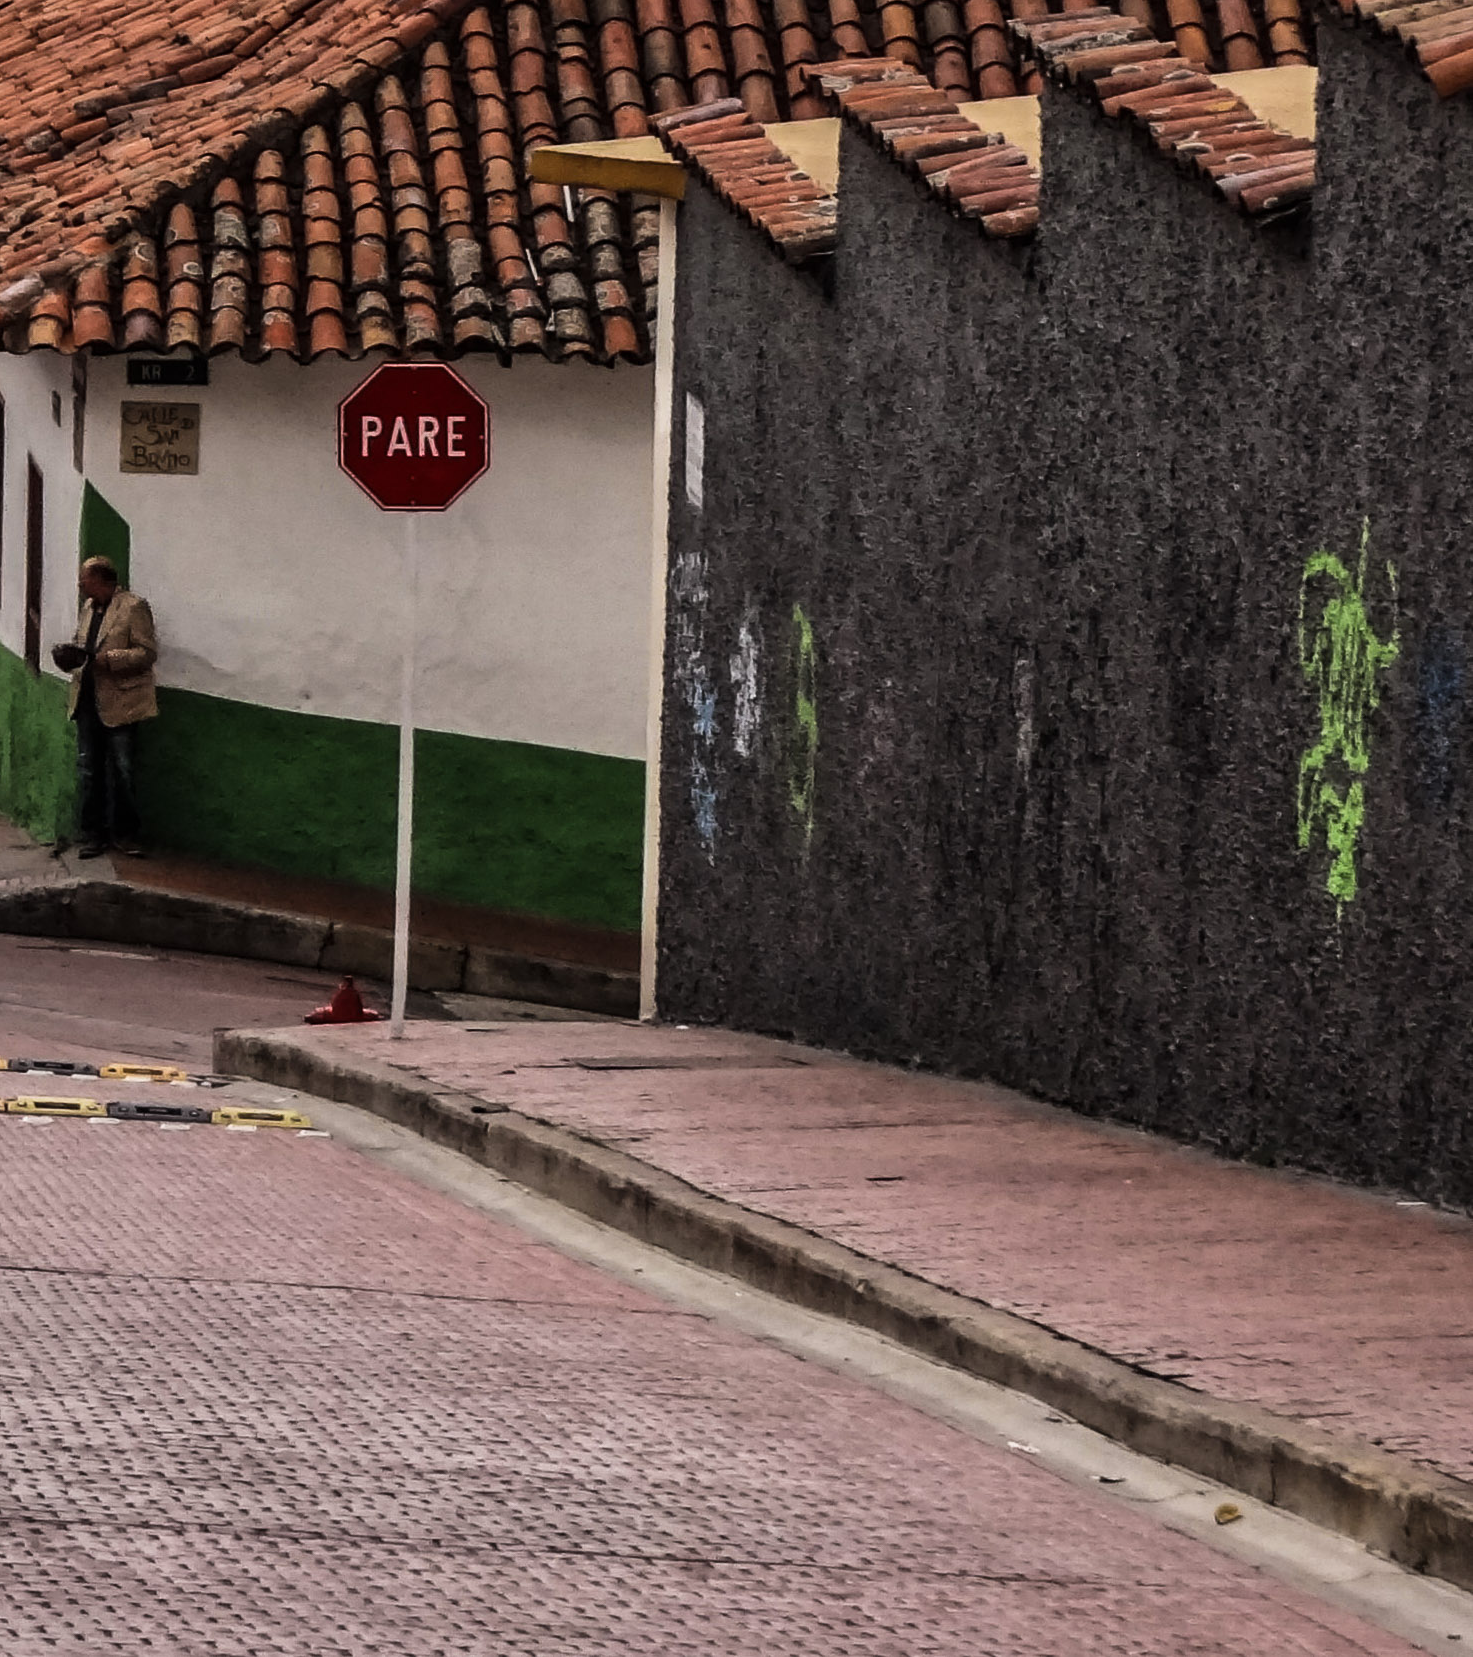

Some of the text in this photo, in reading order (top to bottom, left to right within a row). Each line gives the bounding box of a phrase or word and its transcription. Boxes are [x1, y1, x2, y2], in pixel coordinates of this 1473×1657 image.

[141, 364, 195, 381] KR 2
[361, 415, 466, 457] PARE
